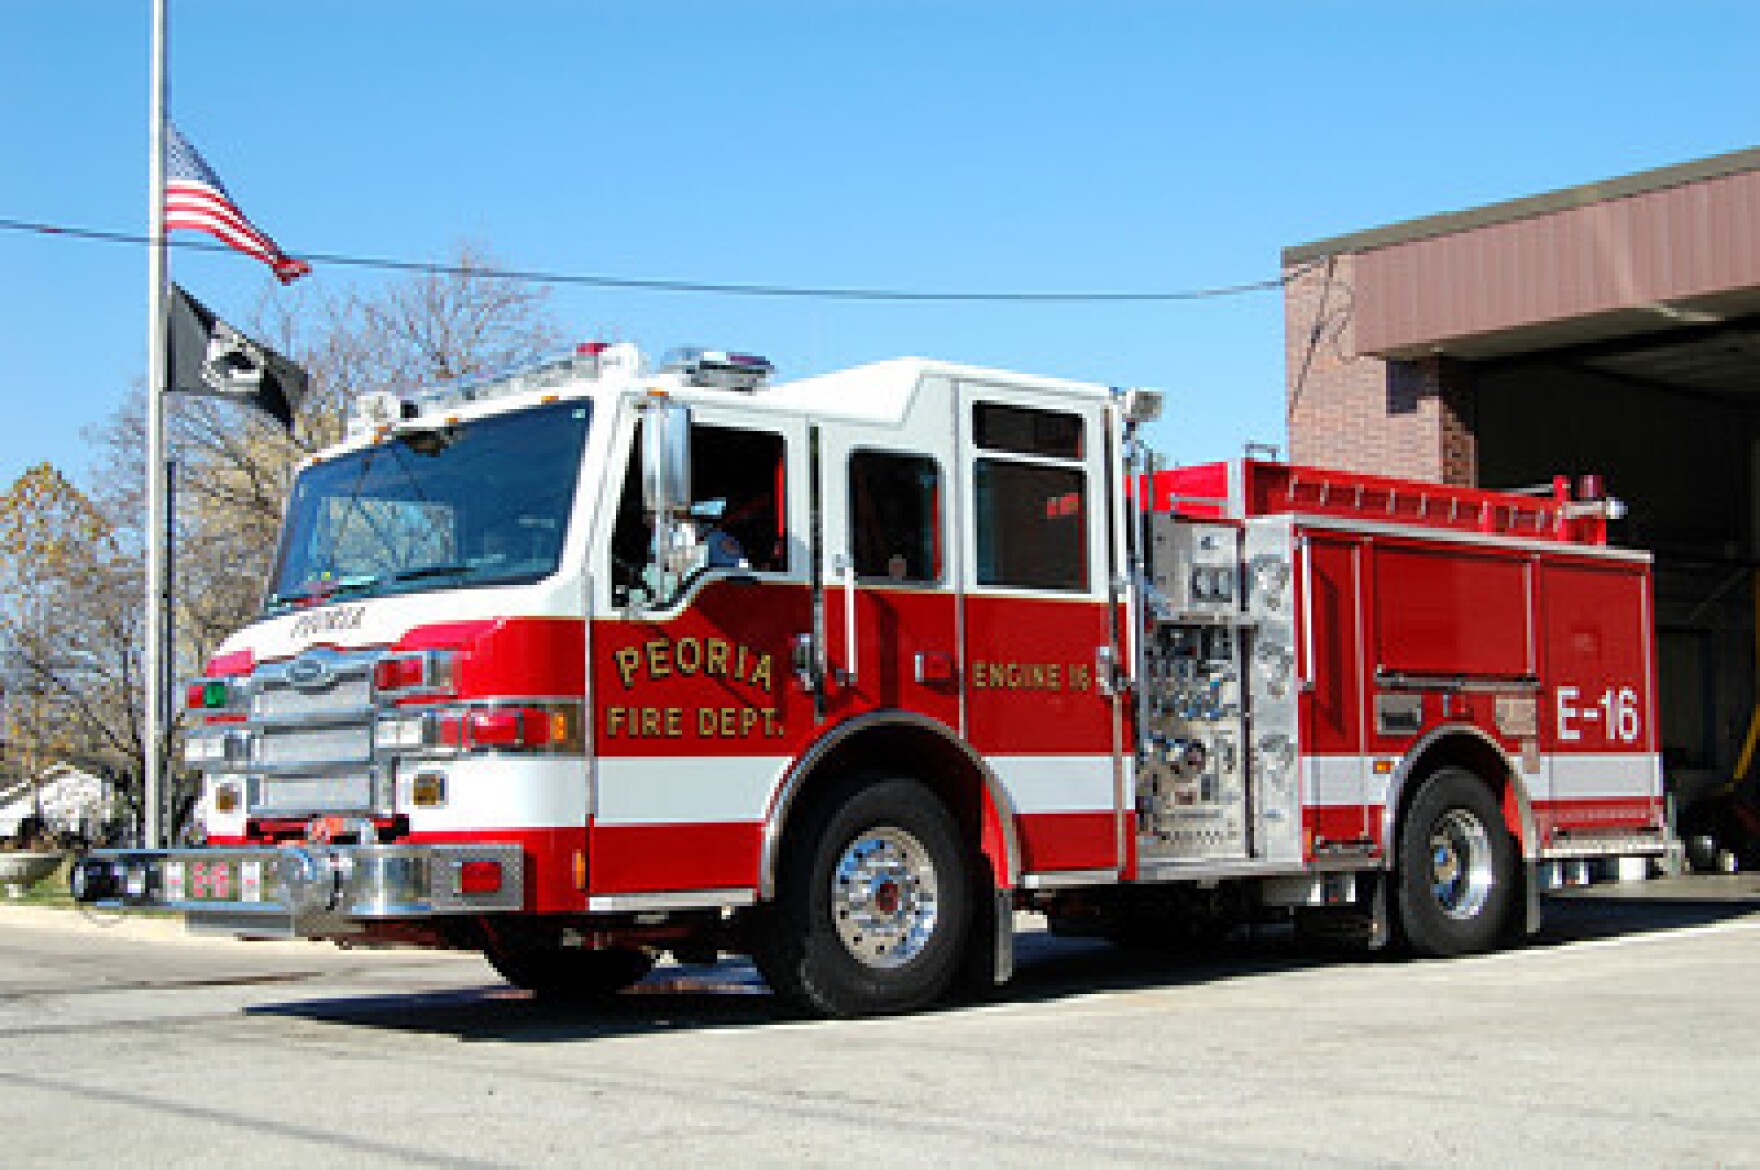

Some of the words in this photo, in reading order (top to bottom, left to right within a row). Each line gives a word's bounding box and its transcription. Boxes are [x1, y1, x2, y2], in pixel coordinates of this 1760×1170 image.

[612, 637, 771, 691] PEORIA
[971, 660, 1061, 690] ENGINE
[606, 706, 683, 739] FIRE
[697, 706, 784, 739] DEPT.
[1556, 685, 1638, 743] E-16
